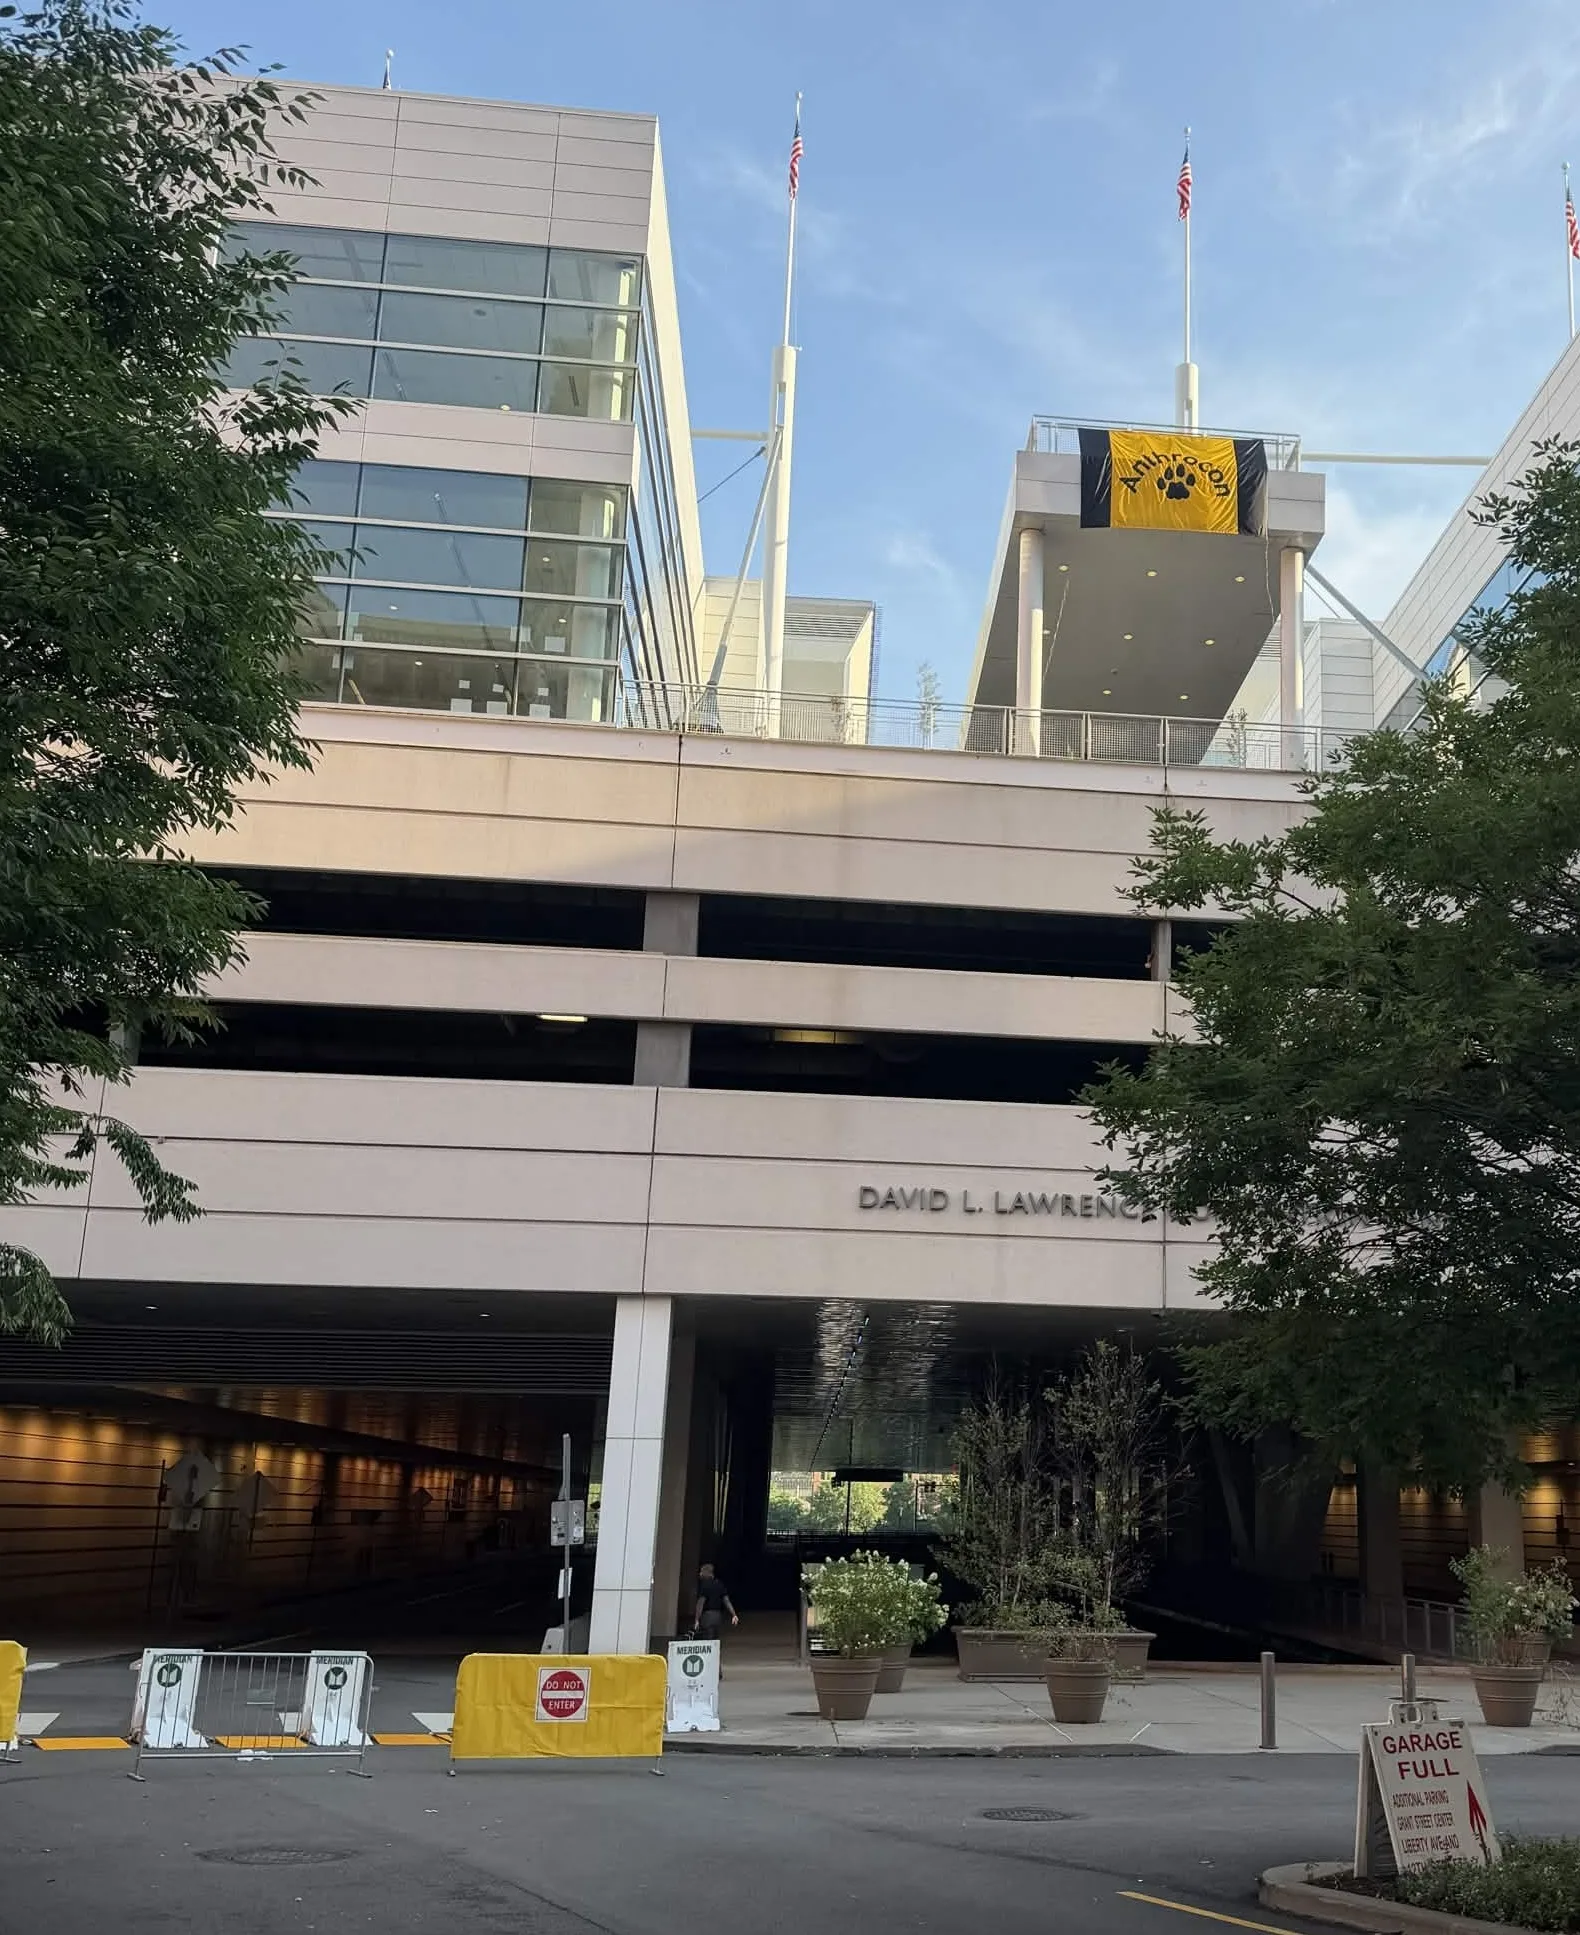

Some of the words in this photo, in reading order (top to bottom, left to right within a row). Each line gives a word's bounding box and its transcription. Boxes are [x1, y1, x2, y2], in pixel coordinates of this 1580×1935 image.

[1119, 451, 1231, 498] Anthrocon
[859, 1185, 949, 1212] DAVID
[962, 1188, 984, 1213] L.
[677, 1645, 712, 1655] MERIDIAN
[546, 1681, 559, 1690] DO
[563, 1680, 582, 1689] NOT
[548, 1700, 576, 1710] ENTER
[1382, 1731, 1463, 1754] GARAGE
[1398, 1758, 1460, 1780] FULL
[1392, 1792, 1425, 1808] ADDITIONAL
[1425, 1790, 1449, 1806] PARKING
[1397, 1815, 1414, 1831] GRANT
[1414, 1814, 1434, 1830] STREET
[1434, 1812, 1455, 1828] CENTER
[1401, 1837, 1429, 1854] LIBERTY
